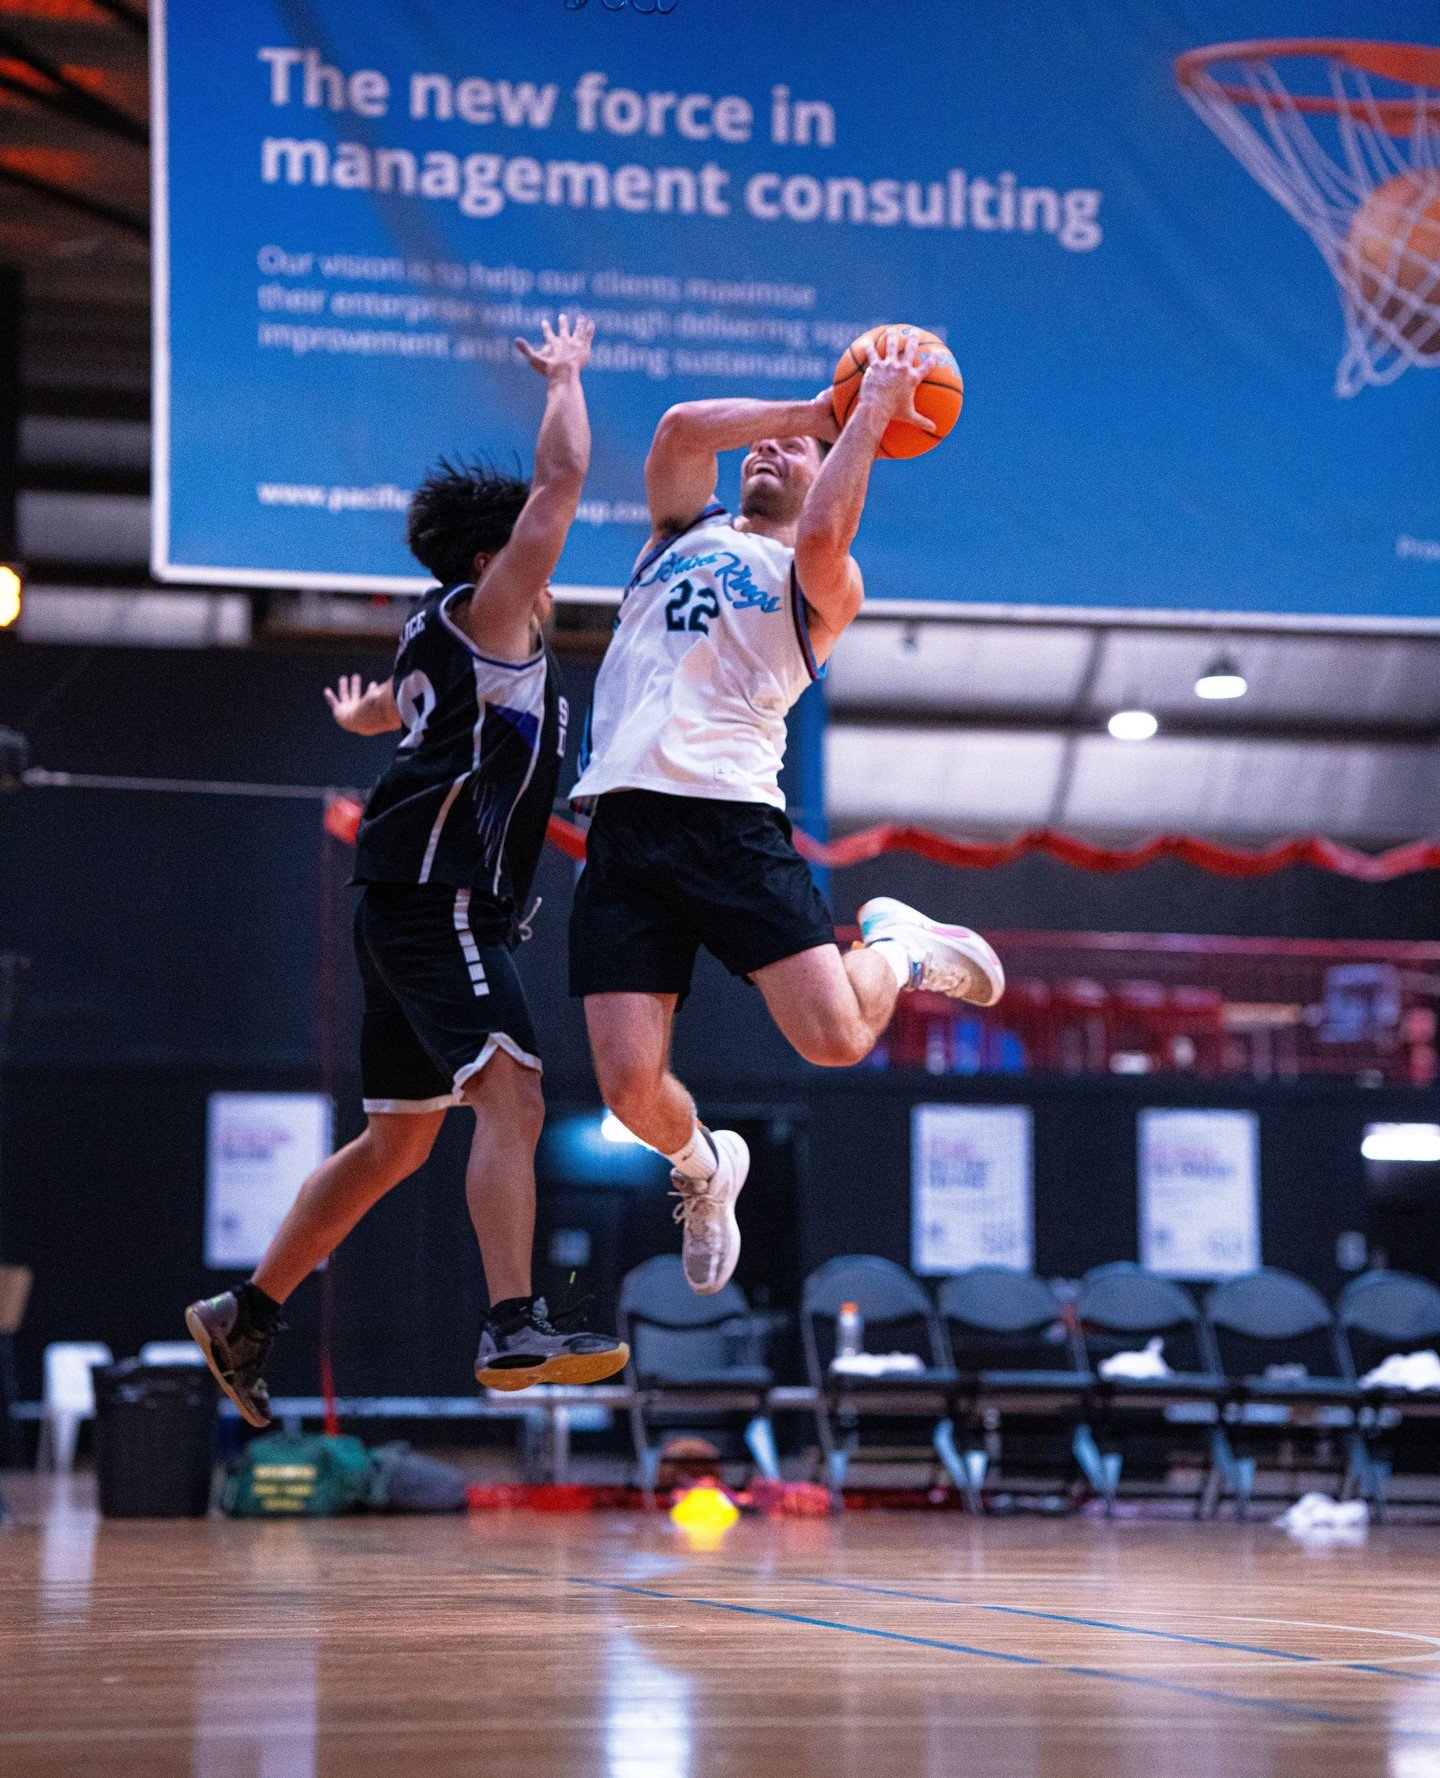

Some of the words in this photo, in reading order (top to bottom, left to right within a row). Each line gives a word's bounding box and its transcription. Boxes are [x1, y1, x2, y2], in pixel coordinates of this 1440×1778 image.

[258, 46, 390, 118] The
[409, 72, 559, 129] new
[573, 71, 754, 143] force
[770, 83, 837, 147] in
[260, 136, 730, 218] management
[744, 166, 1104, 253] consulting
[256, 245, 314, 276] Our
[319, 253, 405, 282] vision
[469, 262, 534, 298] help
[537, 269, 587, 297] our
[257, 283, 325, 315] their
[257, 321, 450, 357] improvement
[665, 578, 720, 636] 22
